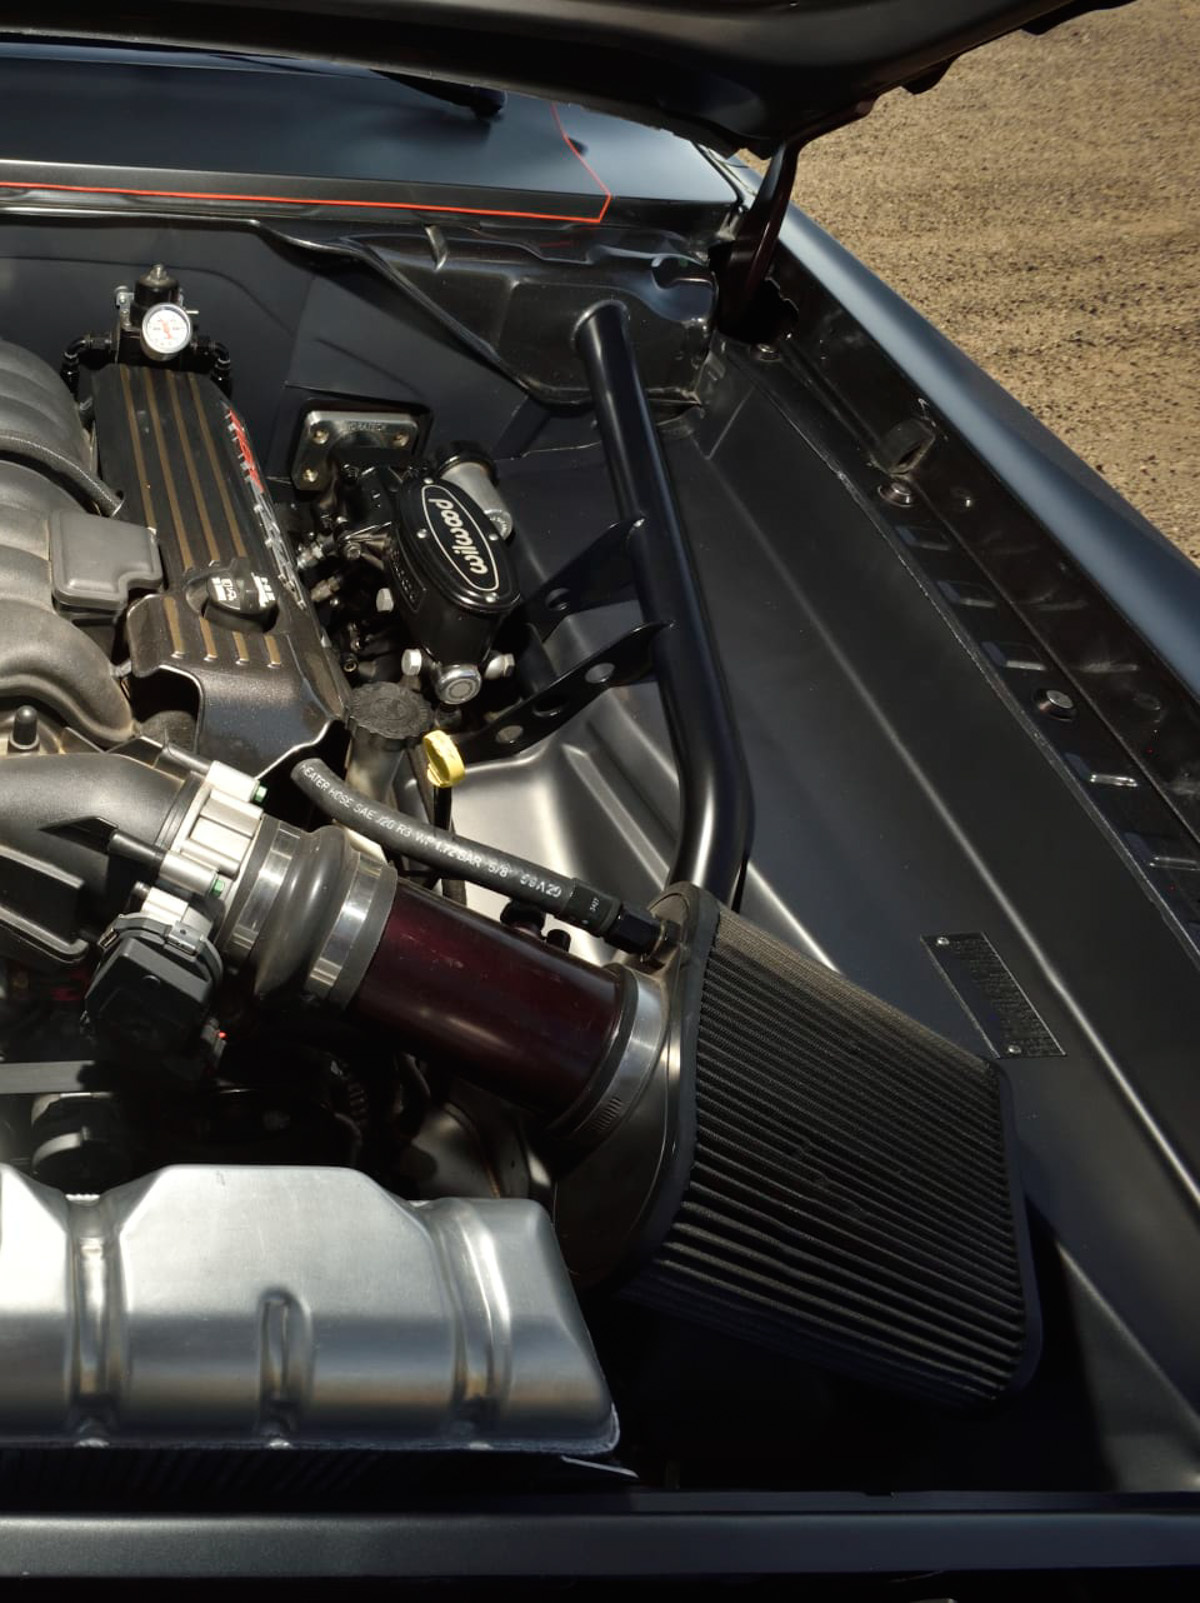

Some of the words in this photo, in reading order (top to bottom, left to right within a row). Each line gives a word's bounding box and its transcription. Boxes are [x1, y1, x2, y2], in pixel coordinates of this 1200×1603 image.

[428, 498, 488, 574] wilwood
[328, 787, 352, 809] HOSE
[352, 802, 377, 821] SAE
[397, 823, 411, 838] R3
